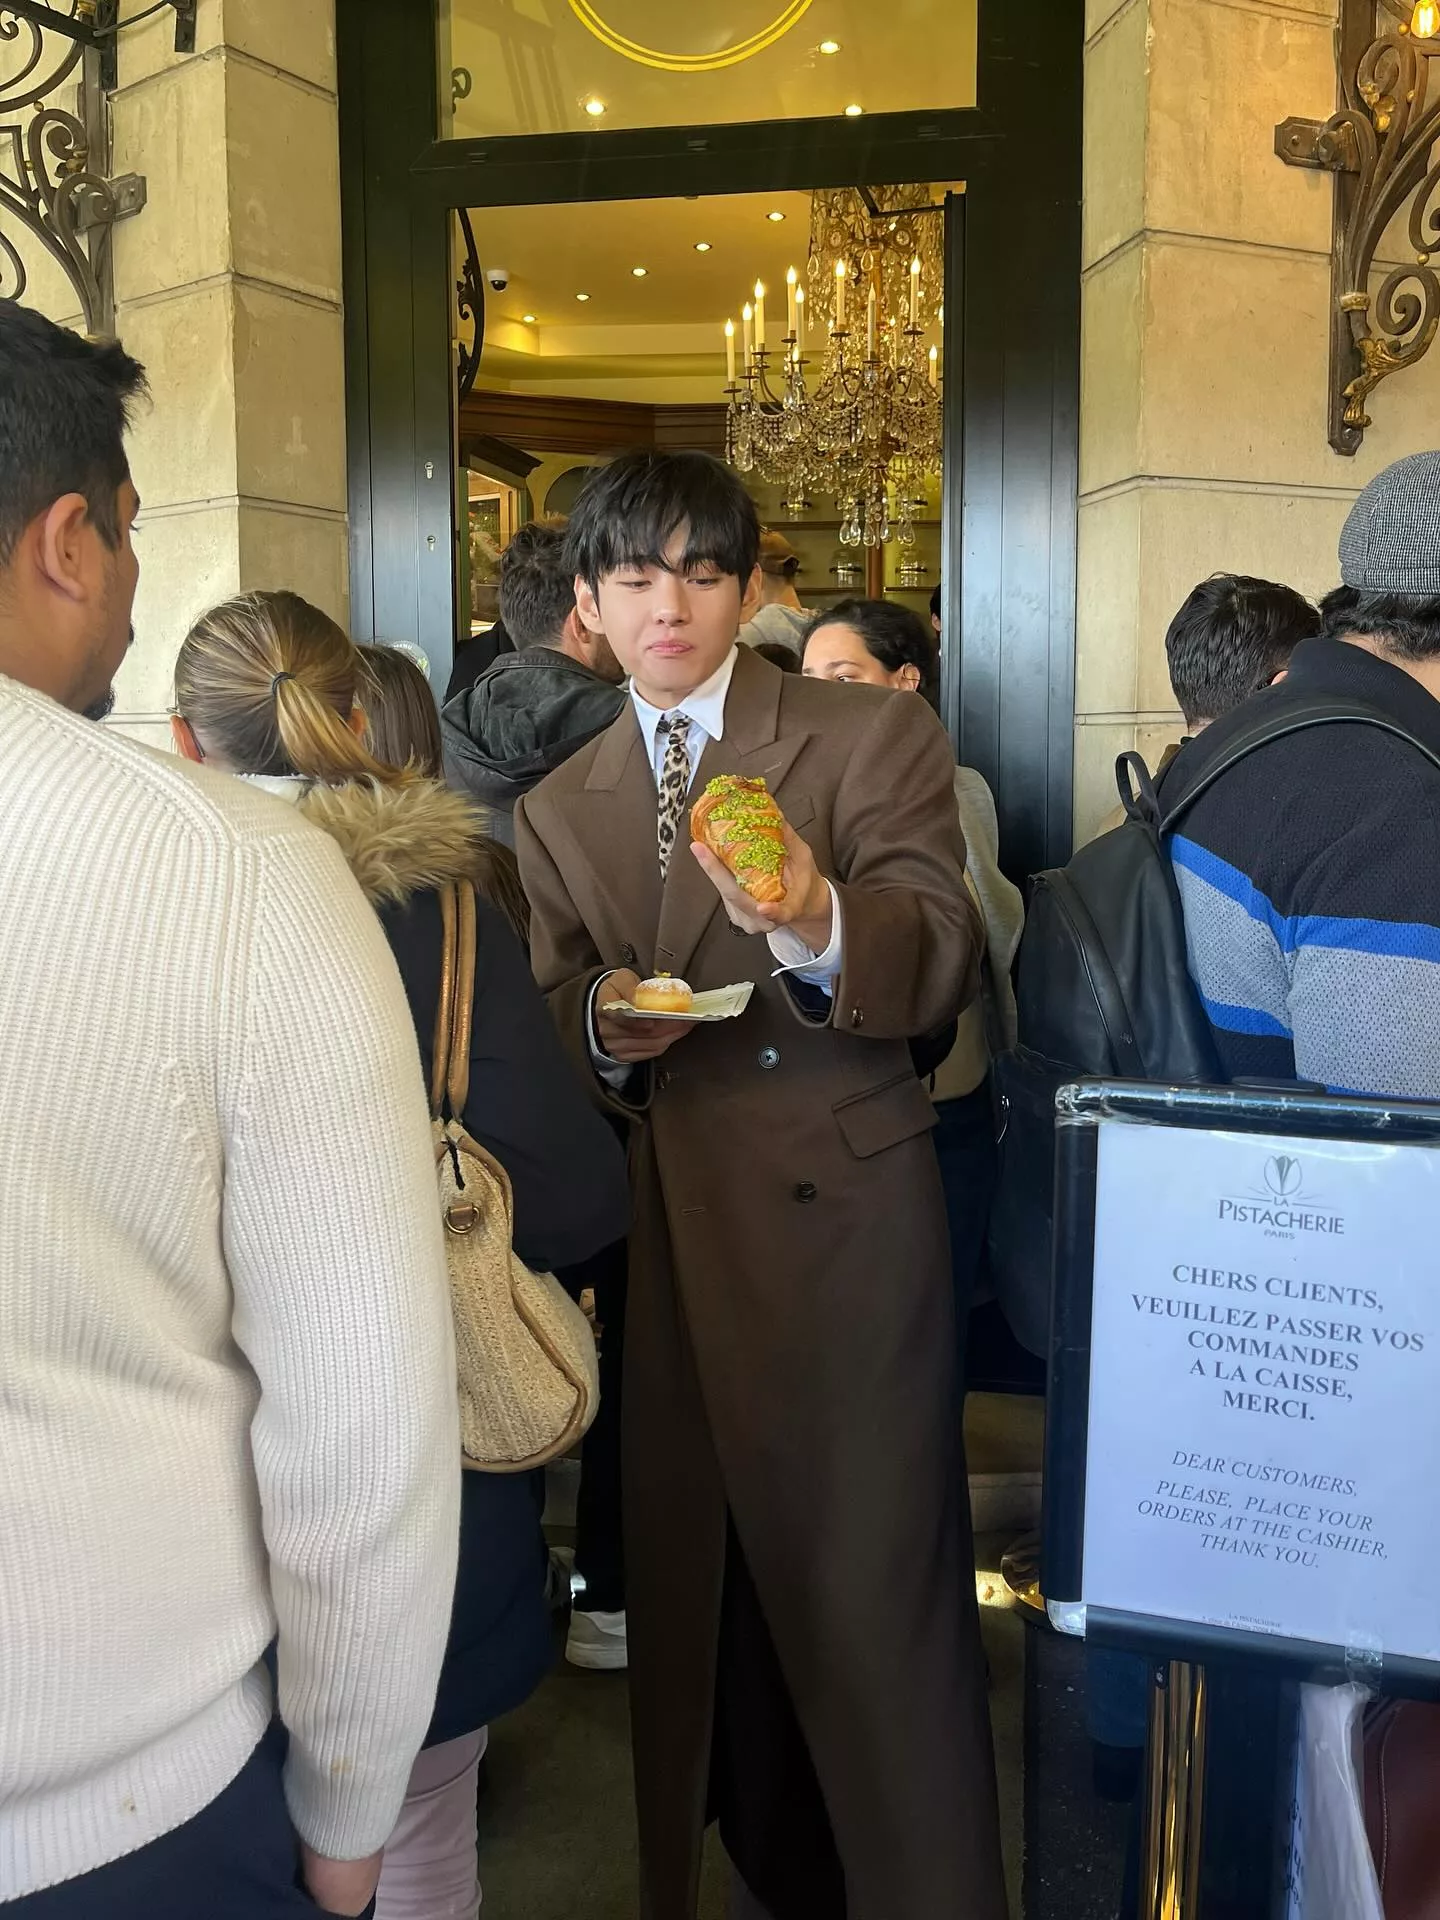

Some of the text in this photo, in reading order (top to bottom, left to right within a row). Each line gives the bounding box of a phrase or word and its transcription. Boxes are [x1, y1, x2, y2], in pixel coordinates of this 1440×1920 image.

[1218, 1199, 1345, 1235] PISTACHERIE
[1273, 1196, 1289, 1207] LA
[1263, 1229, 1296, 1240] PARIS
[1172, 1264, 1383, 1312] CHERS CLIENTS,
[1131, 1294, 1424, 1352] VEUILLEZ PASSER VOS
[1187, 1330, 1359, 1371] COMMANDES
[1189, 1357, 1353, 1402] A LA CAISSE,
[1223, 1389, 1315, 1421] MERCI.
[1172, 1450, 1357, 1497] DEAR CUSTOMERS,
[1138, 1500, 1388, 1560] ORDERS AT THE CASHIER,
[1246, 1497, 1311, 1521] PLACE
[1318, 1508, 1373, 1532] YOUR
[1200, 1533, 1319, 1569] THANK YOU.
